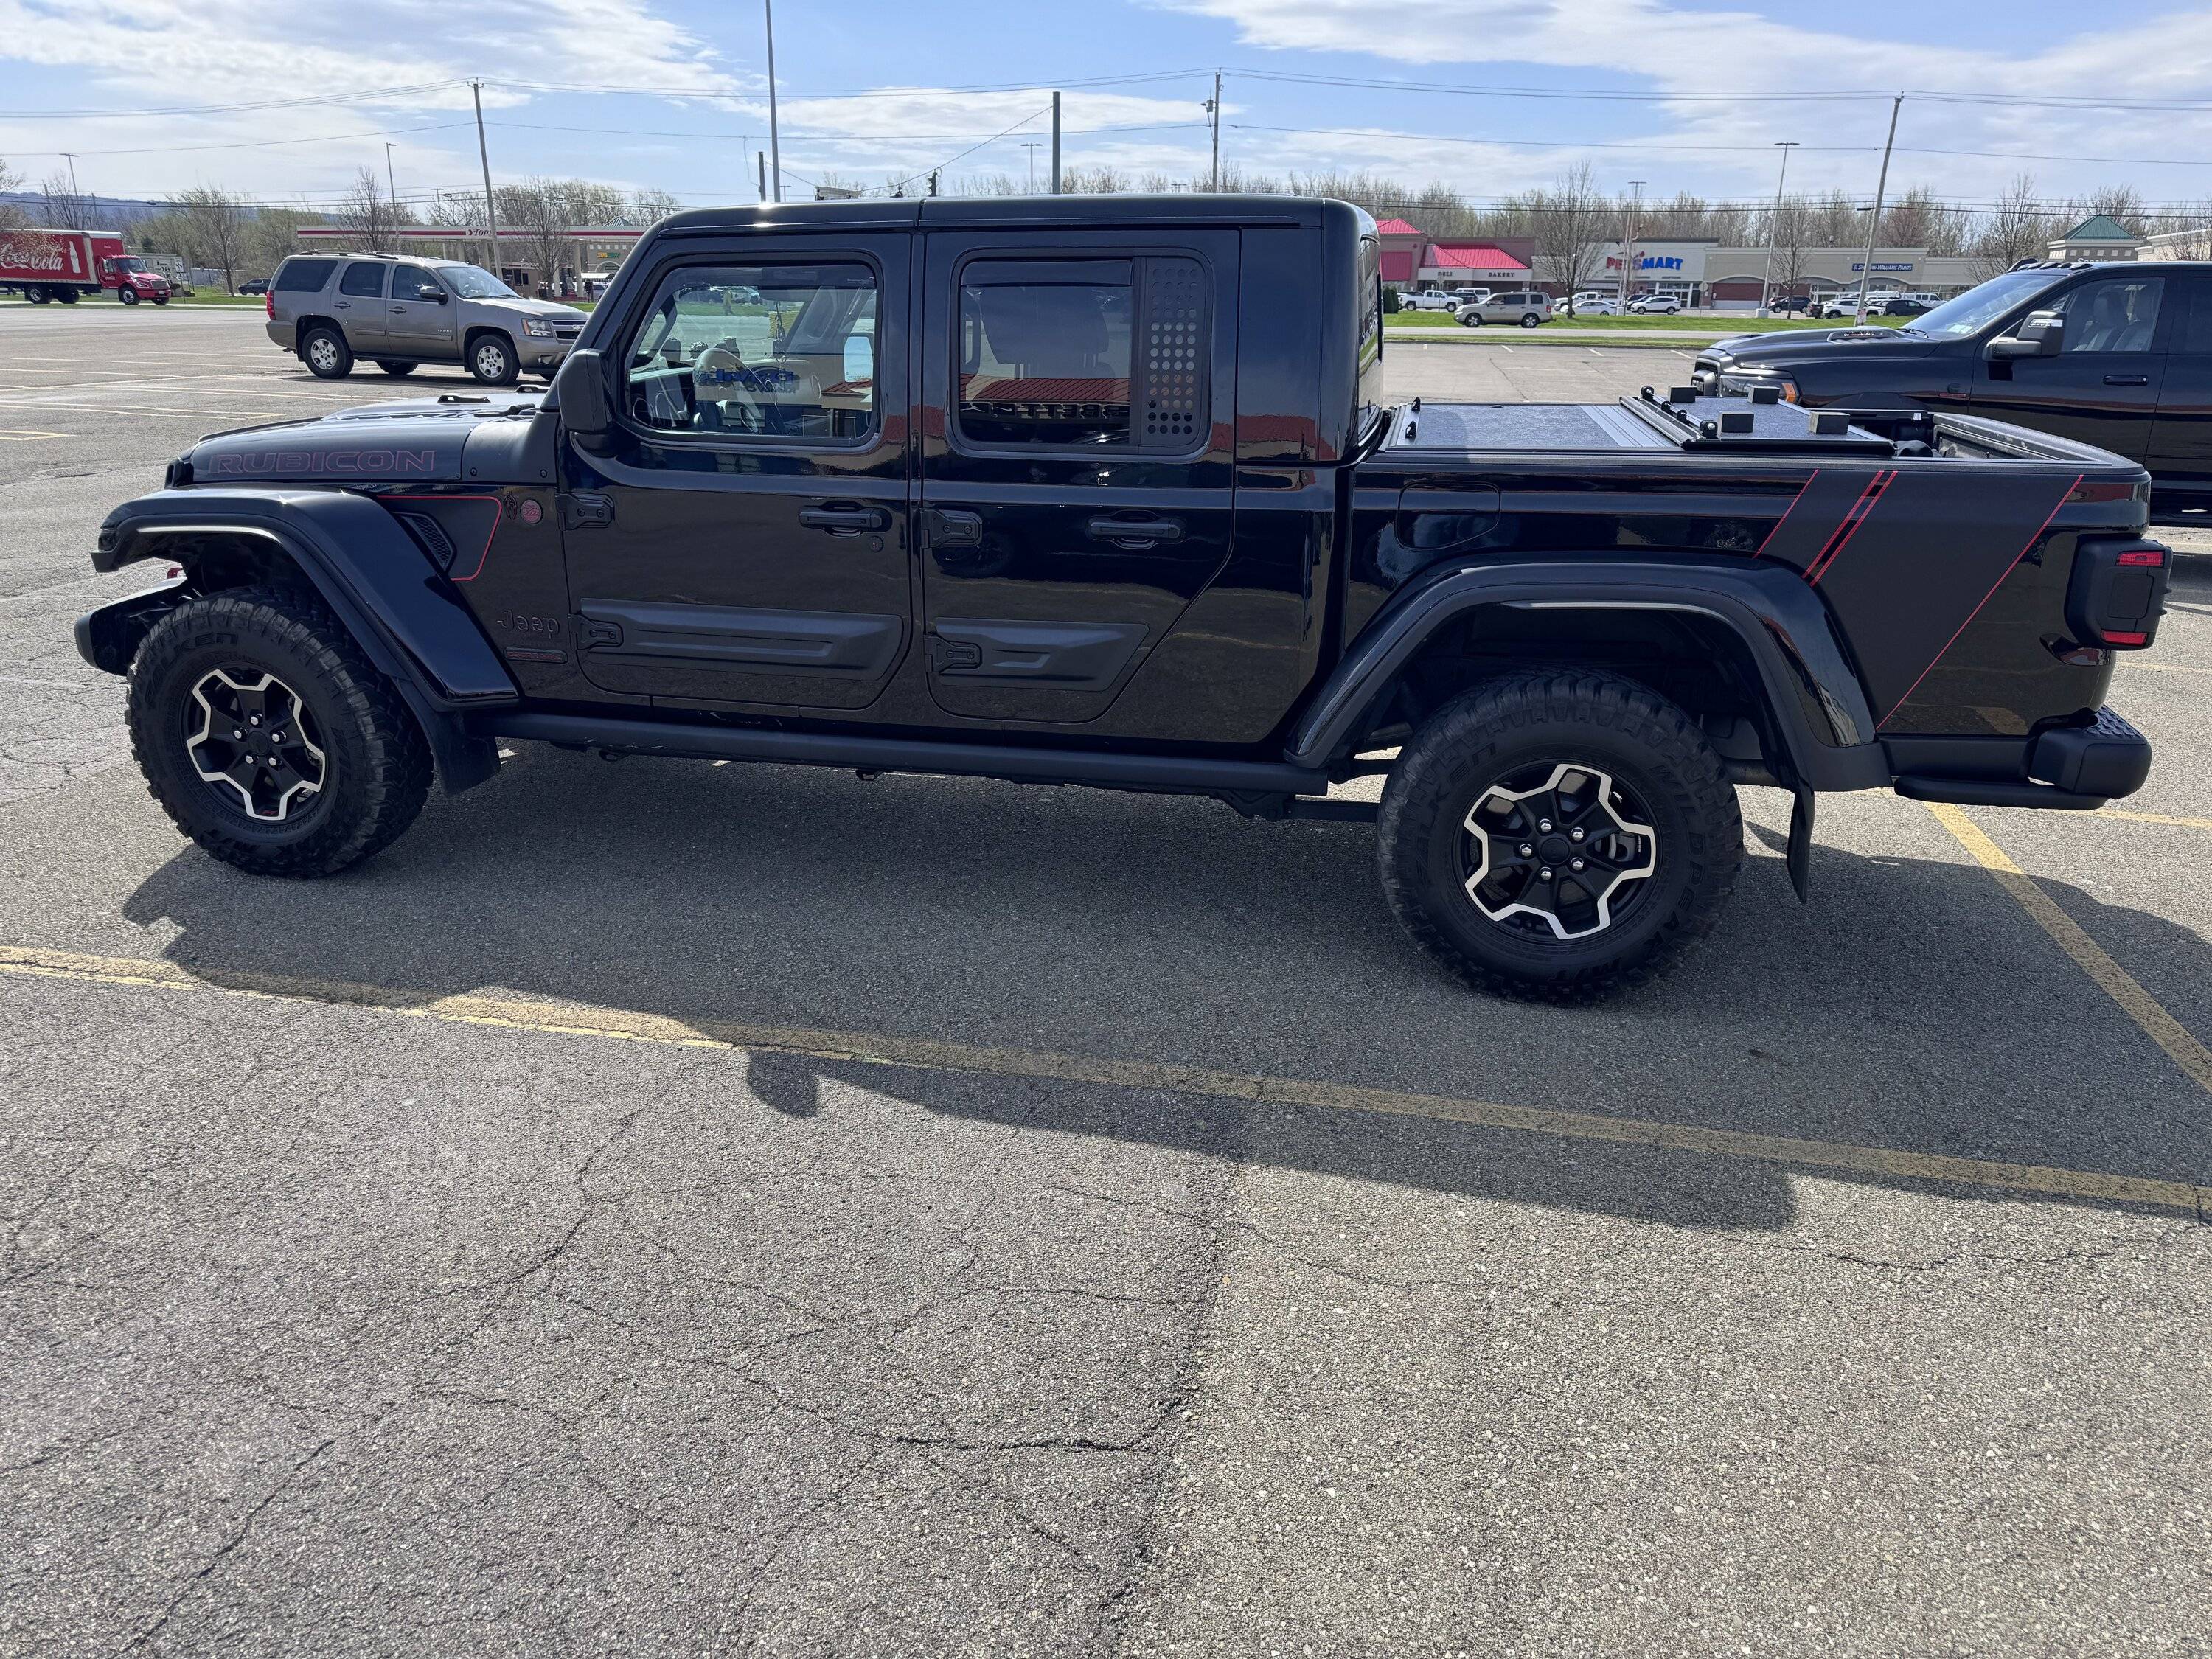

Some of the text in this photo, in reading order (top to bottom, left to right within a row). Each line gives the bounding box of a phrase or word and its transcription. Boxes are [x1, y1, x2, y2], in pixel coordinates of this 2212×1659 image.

[1606, 257, 1683, 270] PESMART
[208, 451, 435, 474] RUBICON
[496, 609, 560, 640] Jeep
